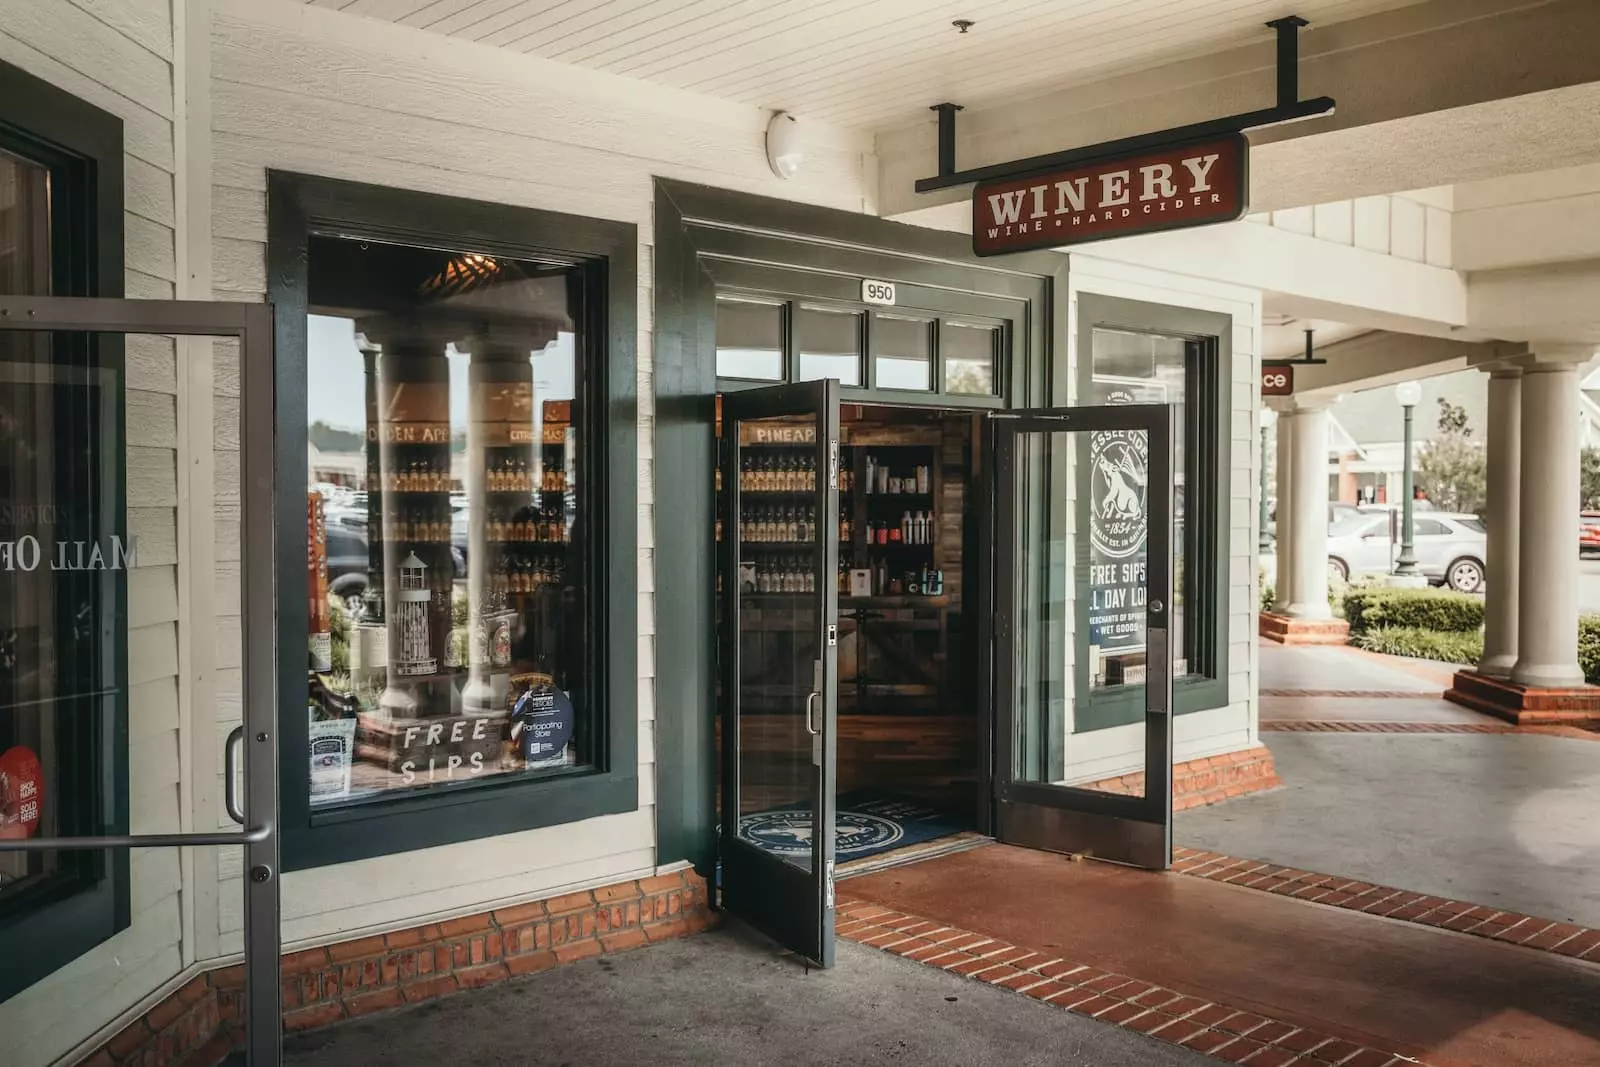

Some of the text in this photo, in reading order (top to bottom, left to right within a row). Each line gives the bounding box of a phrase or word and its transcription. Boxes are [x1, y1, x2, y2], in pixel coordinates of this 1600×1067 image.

[988, 154, 1219, 226] WINERY
[988, 193, 1221, 239] WINE HARD CIDER
[867, 283, 893, 301] 950
[756, 429, 815, 443] PINEAP
[1090, 562, 1147, 585] FREE SIPS
[1089, 590, 1100, 611] L
[1104, 588, 1127, 609] DAY
[1100, 625, 1115, 636] WET
[404, 718, 489, 749] FREE
[523, 721, 563, 732] Participating
[534, 730, 552, 738] Store
[401, 751, 484, 785] SIPS
[20, 800, 37, 814] SOLD
